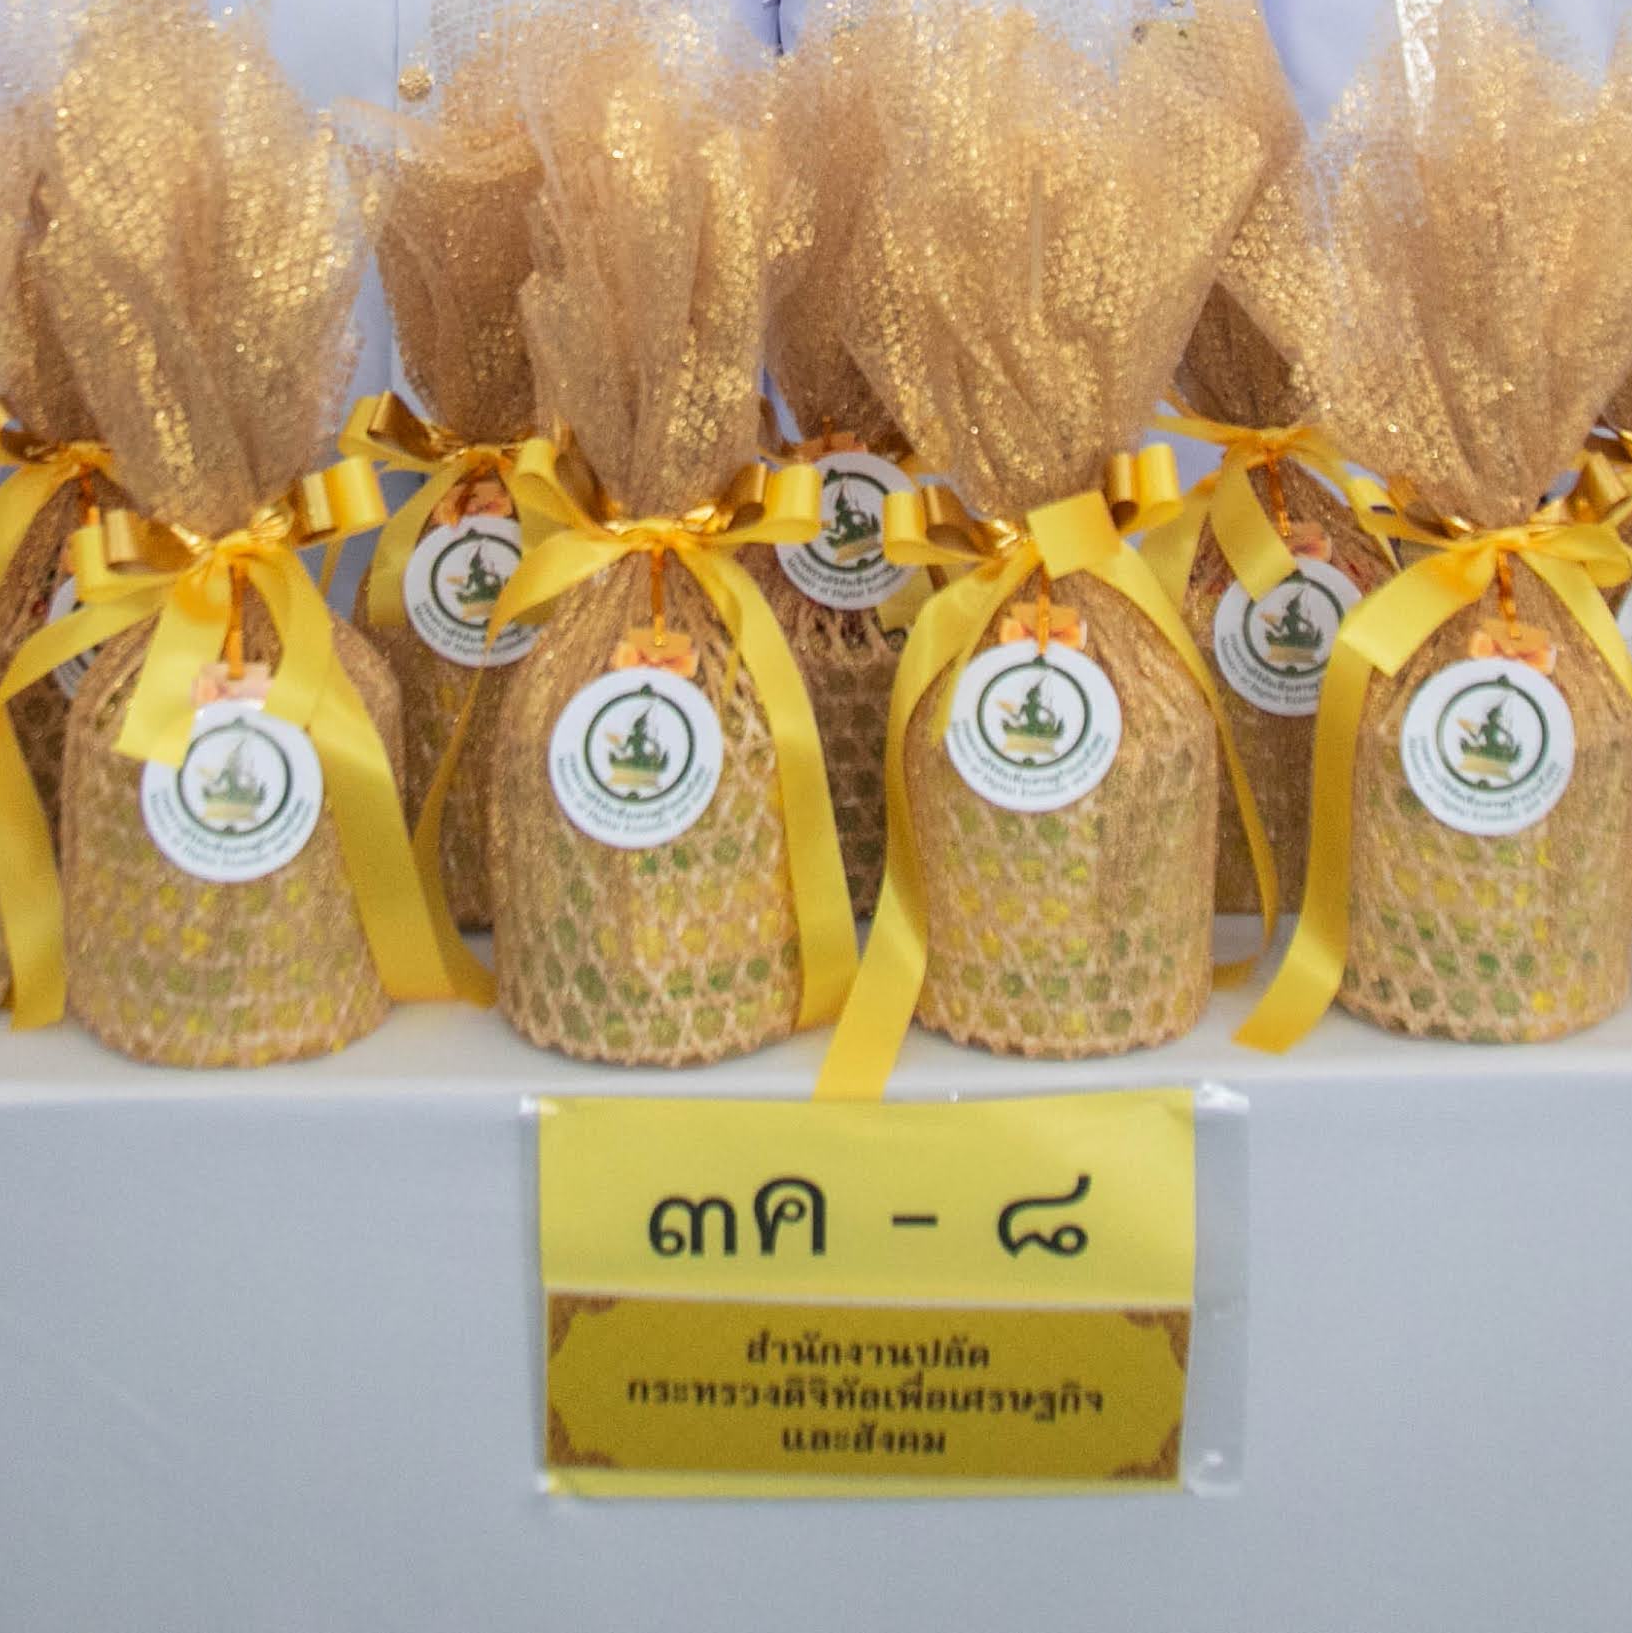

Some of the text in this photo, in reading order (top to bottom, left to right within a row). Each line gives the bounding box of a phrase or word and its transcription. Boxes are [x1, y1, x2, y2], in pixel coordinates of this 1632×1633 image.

[648, 1172, 1091, 1258] ๓ค - ๘
[746, 1329, 990, 1368] สำนักงานปลัด
[627, 1369, 1105, 1423] กระทรวงดิจิทัลเพื่อเศรษฐกิจ
[782, 1421, 947, 1454] และสังคม
